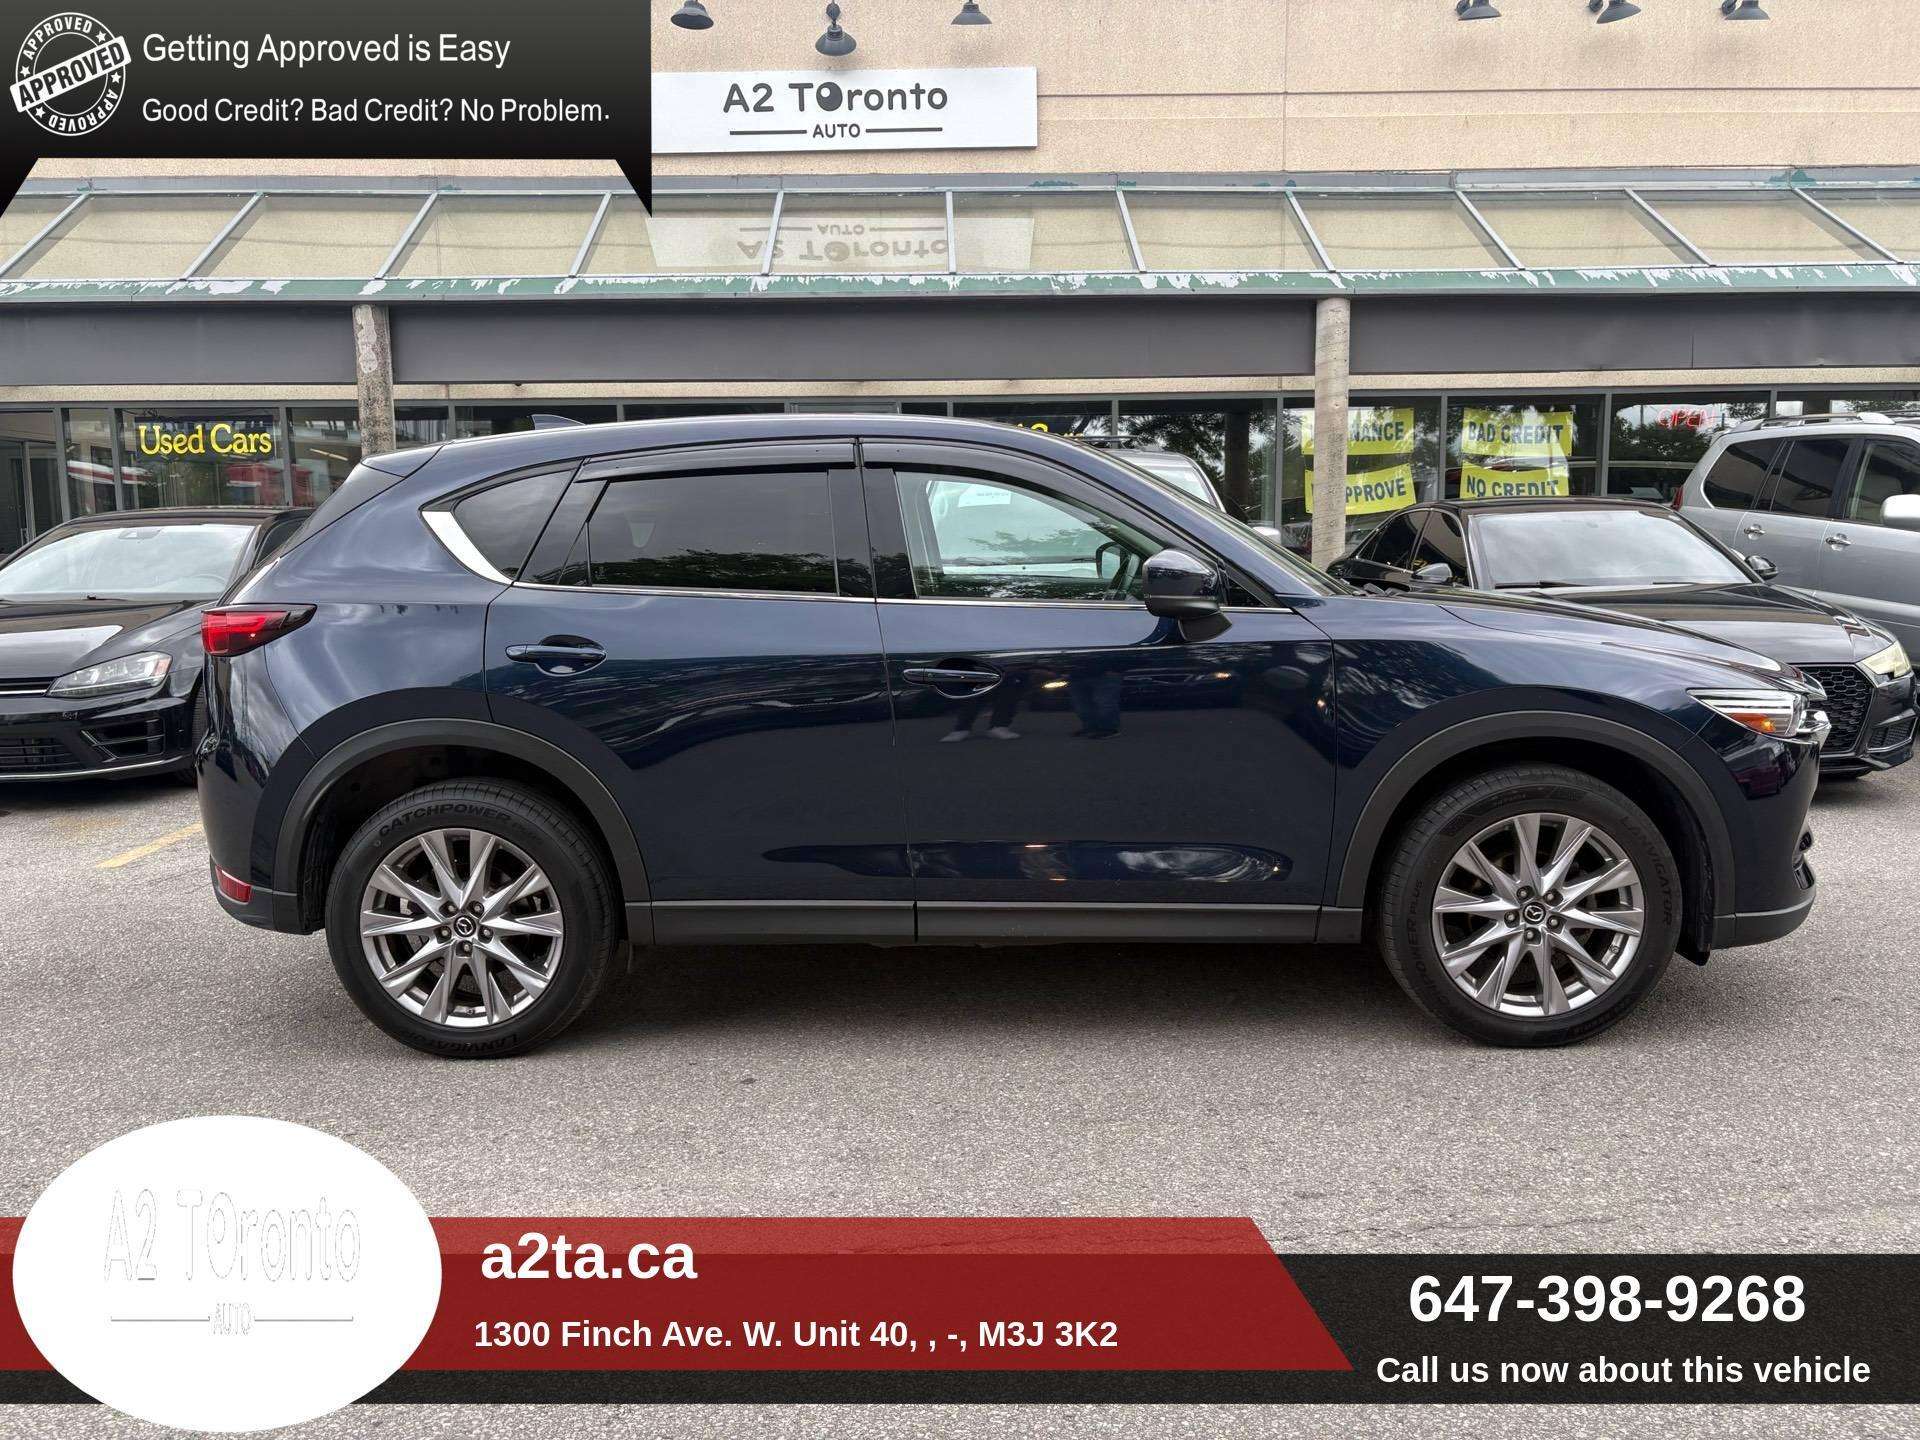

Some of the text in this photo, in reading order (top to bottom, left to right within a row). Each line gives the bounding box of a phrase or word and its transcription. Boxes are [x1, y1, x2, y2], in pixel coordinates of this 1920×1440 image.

[723, 82, 774, 113] A2
[812, 123, 861, 139] AUTO
[139, 423, 272, 455] Used Cars
[1469, 421, 1563, 444] BAD CREDIT
[1346, 478, 1406, 503] PPROVE
[1467, 475, 1558, 497] NO CREDIT
[379, 804, 511, 838] CATCHPOWER
